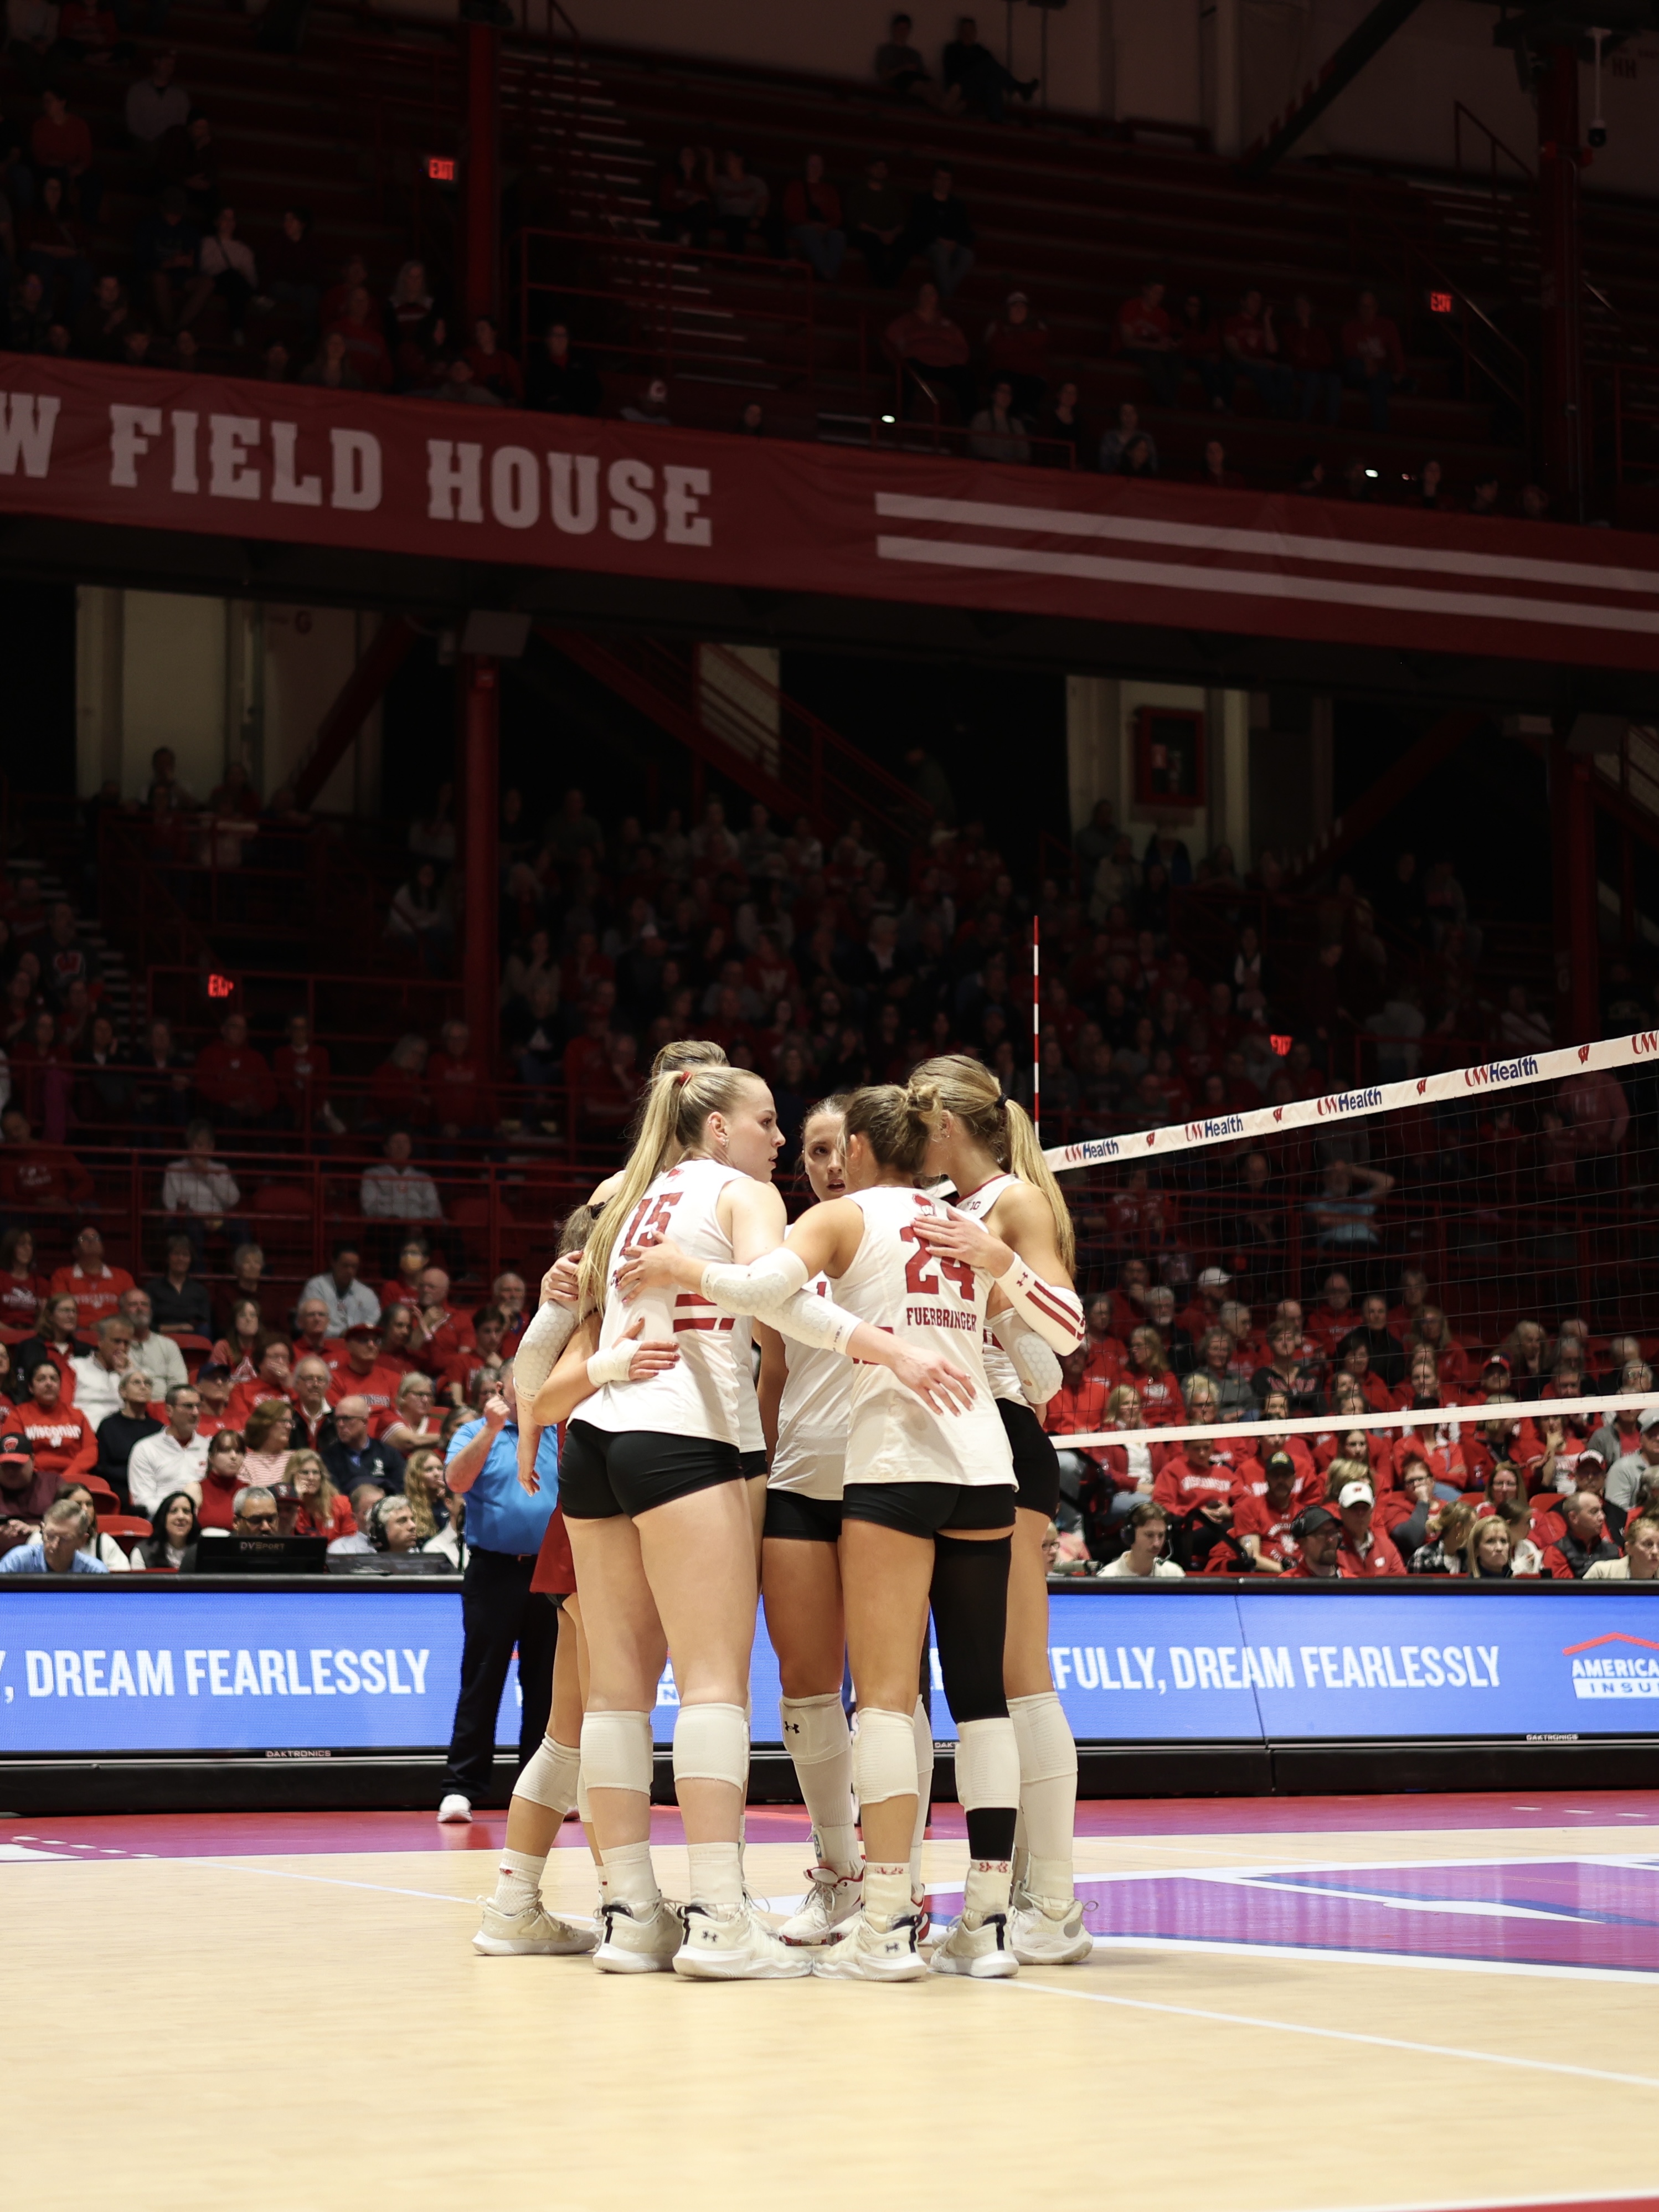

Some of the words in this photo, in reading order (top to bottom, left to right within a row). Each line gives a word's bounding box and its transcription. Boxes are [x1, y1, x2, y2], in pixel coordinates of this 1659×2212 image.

[110, 404, 383, 511] FIELD
[427, 439, 712, 546] HOUSE
[618, 1191, 684, 1257] 15
[899, 1225, 975, 1302] 24
[906, 1307, 977, 1333] FUERBRINGER
[25, 1649, 175, 1698] DREAM
[183, 1648, 430, 1695] FEARLESSLY
[1048, 1645, 1166, 1695] FULLY,
[1168, 1646, 1295, 1690] DREAM
[1299, 1645, 1500, 1689] FEARLESSLY
